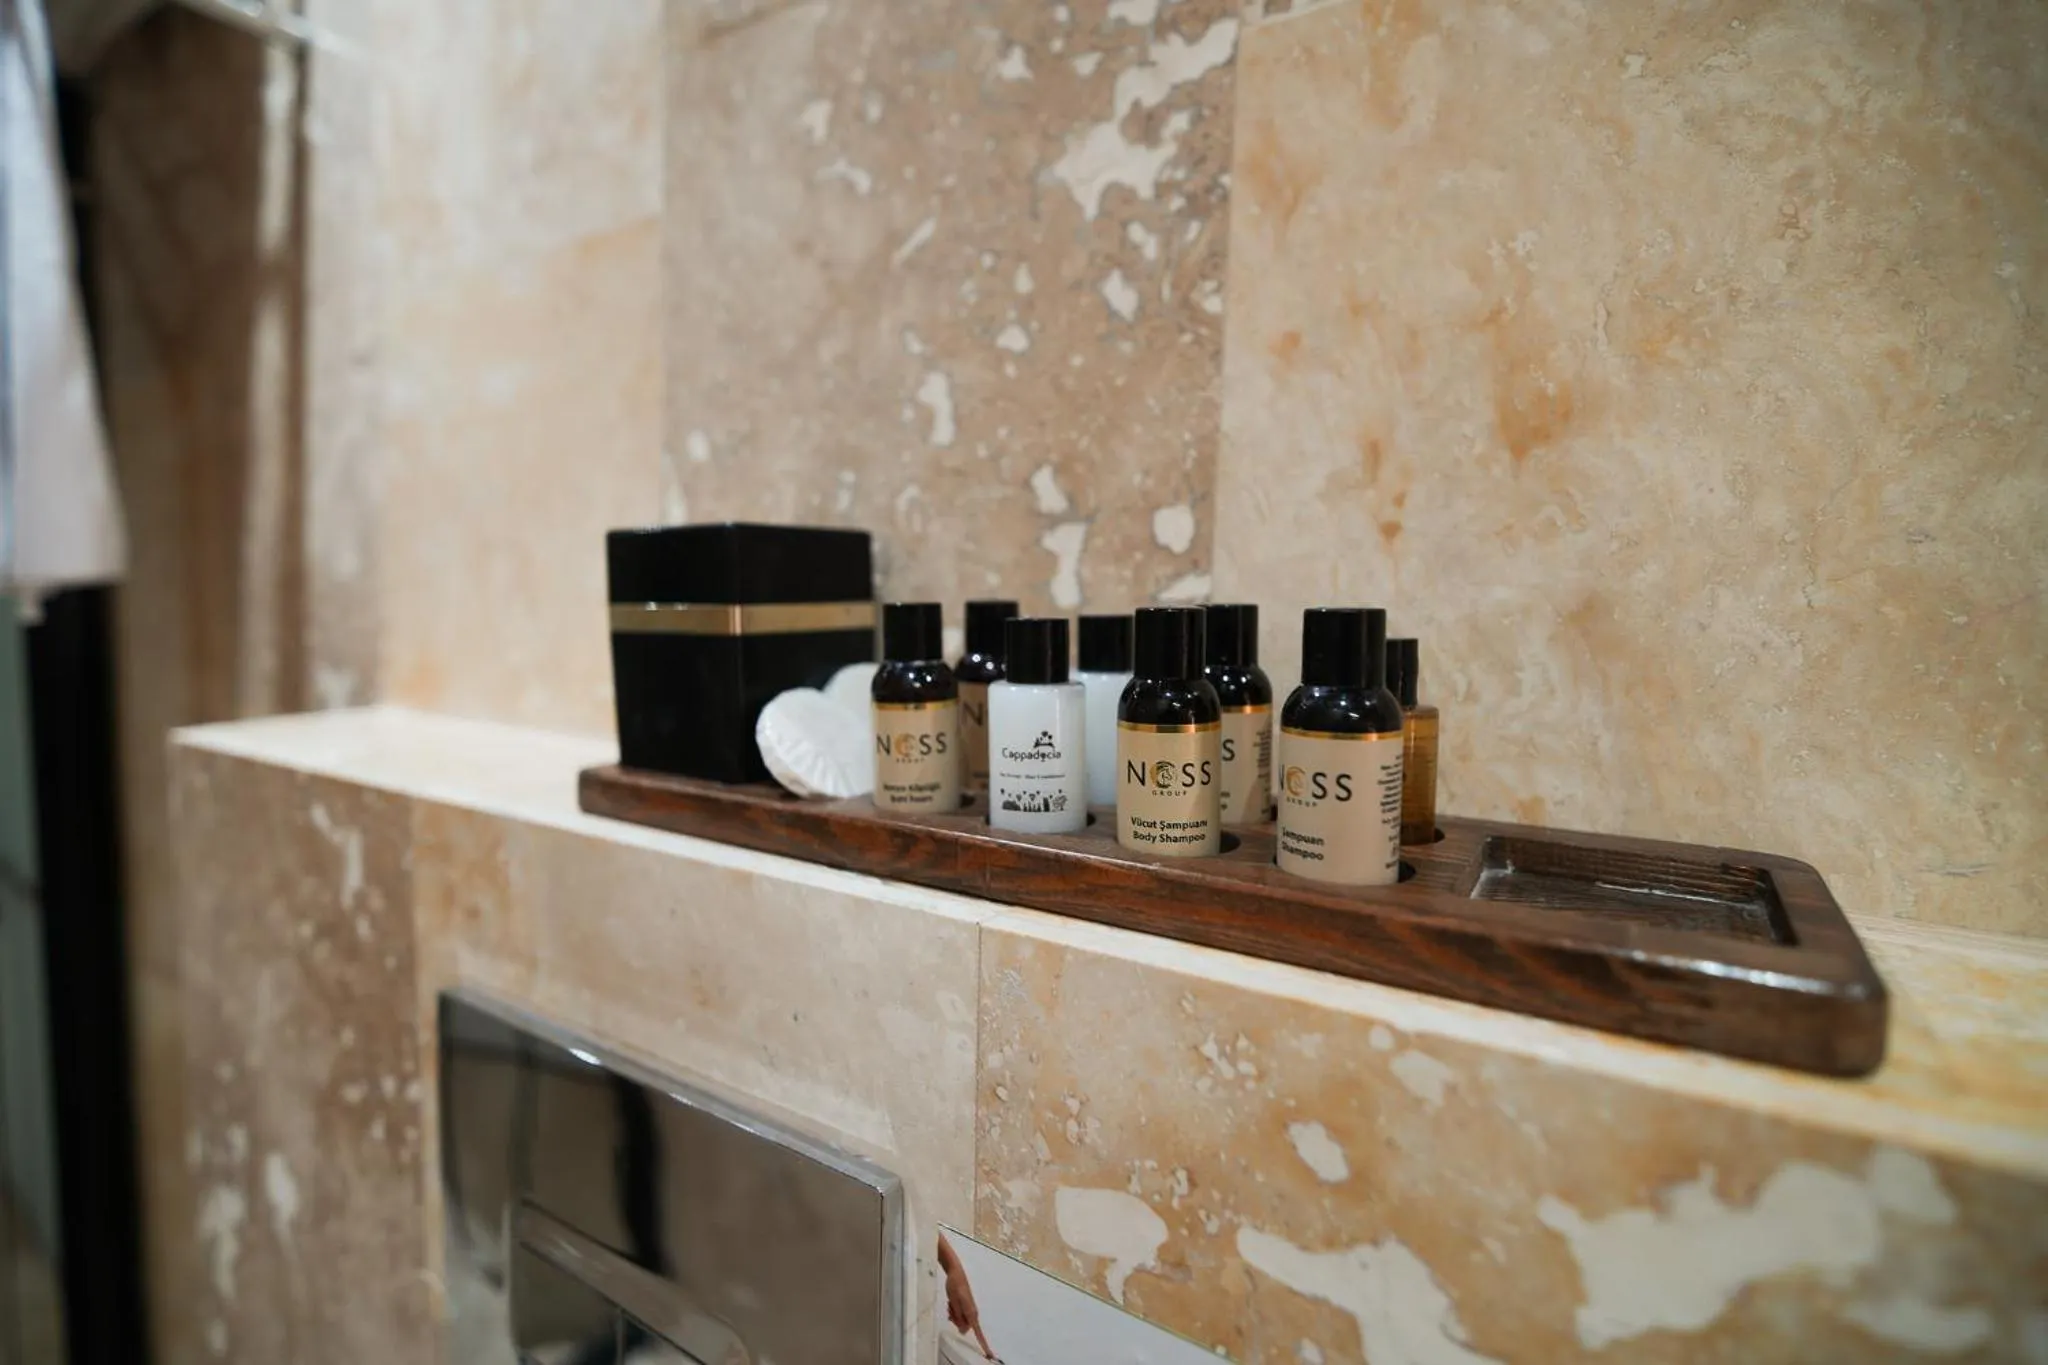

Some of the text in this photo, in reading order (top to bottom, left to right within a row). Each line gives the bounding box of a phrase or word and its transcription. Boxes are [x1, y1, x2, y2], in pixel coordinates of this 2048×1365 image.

[1001, 747, 1062, 762] Cappadocia
[1131, 816, 1157, 829] Vücut
[1133, 831, 1206, 844] Body Shampoo
